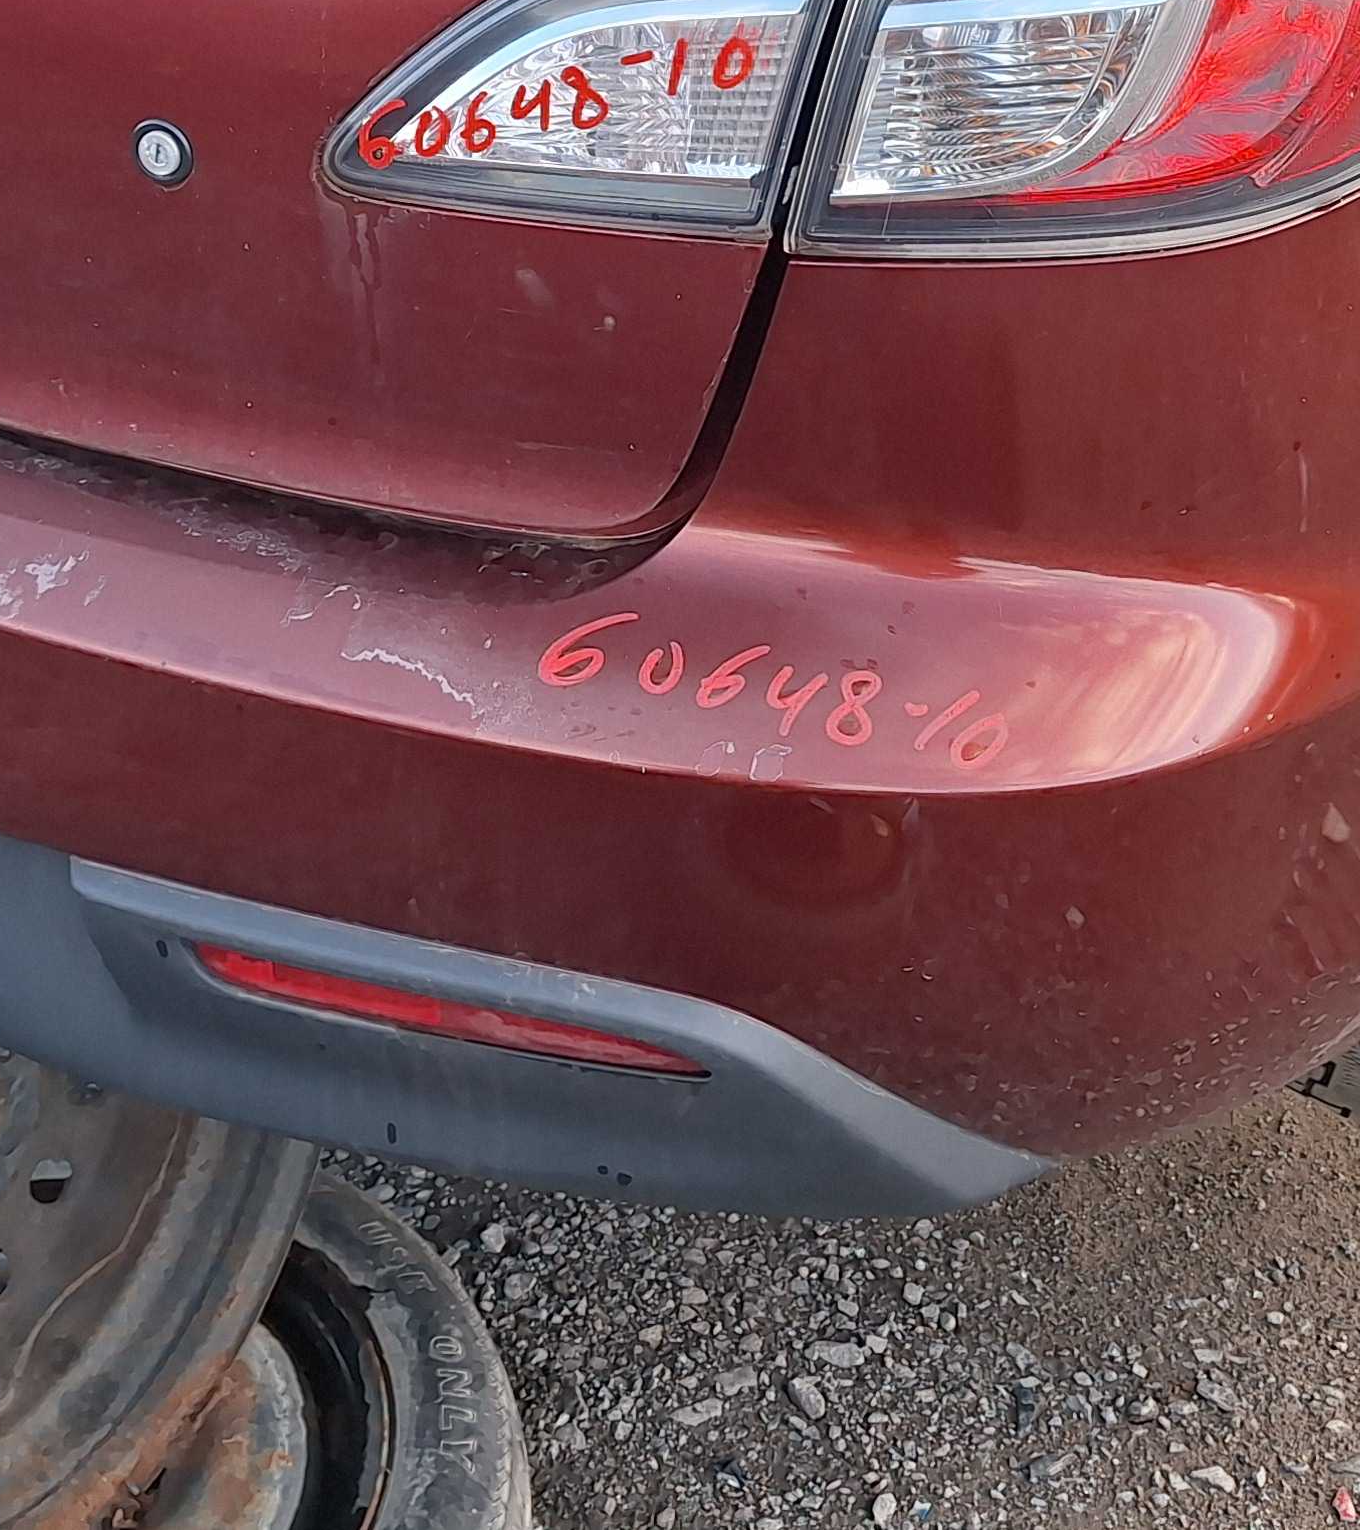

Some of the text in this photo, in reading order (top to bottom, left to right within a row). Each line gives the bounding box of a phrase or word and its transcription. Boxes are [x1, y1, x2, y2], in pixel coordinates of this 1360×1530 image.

[358, 36, 755, 169] 60648-10
[538, 611, 1009, 769] 60648-10
[429, 1335, 478, 1474] ONLY
